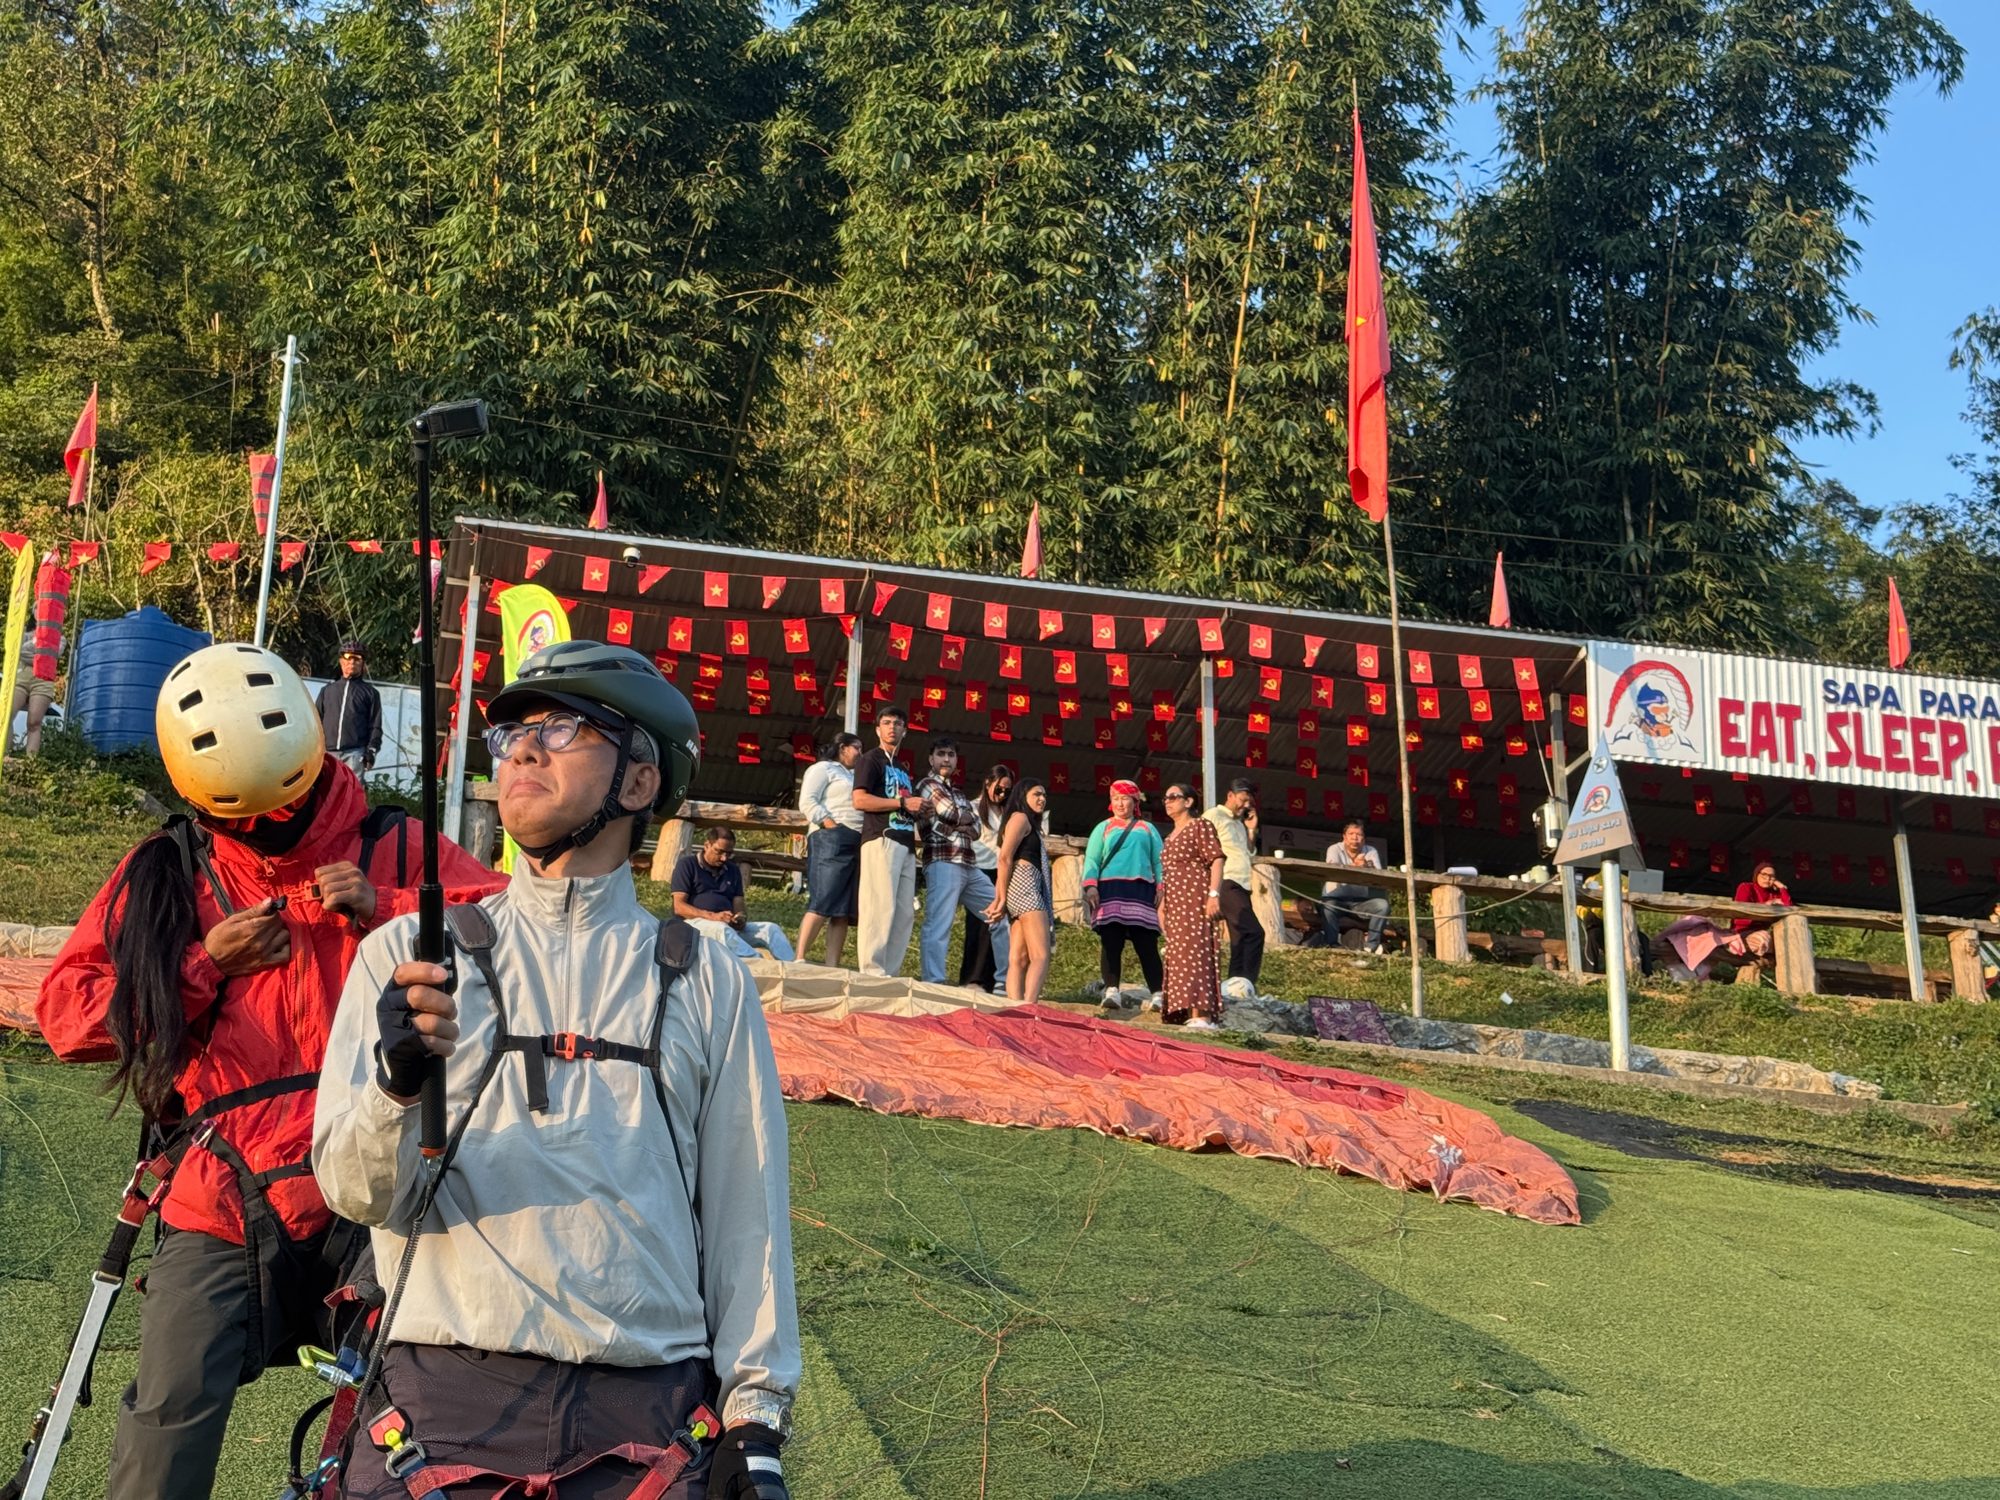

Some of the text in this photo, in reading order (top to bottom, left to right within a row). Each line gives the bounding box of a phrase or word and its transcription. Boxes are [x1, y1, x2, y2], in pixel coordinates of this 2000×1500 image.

[1823, 679, 1901, 711] SAPA
[1718, 697, 1816, 776] EAT,
[1826, 711, 1978, 792] SLEEP,
